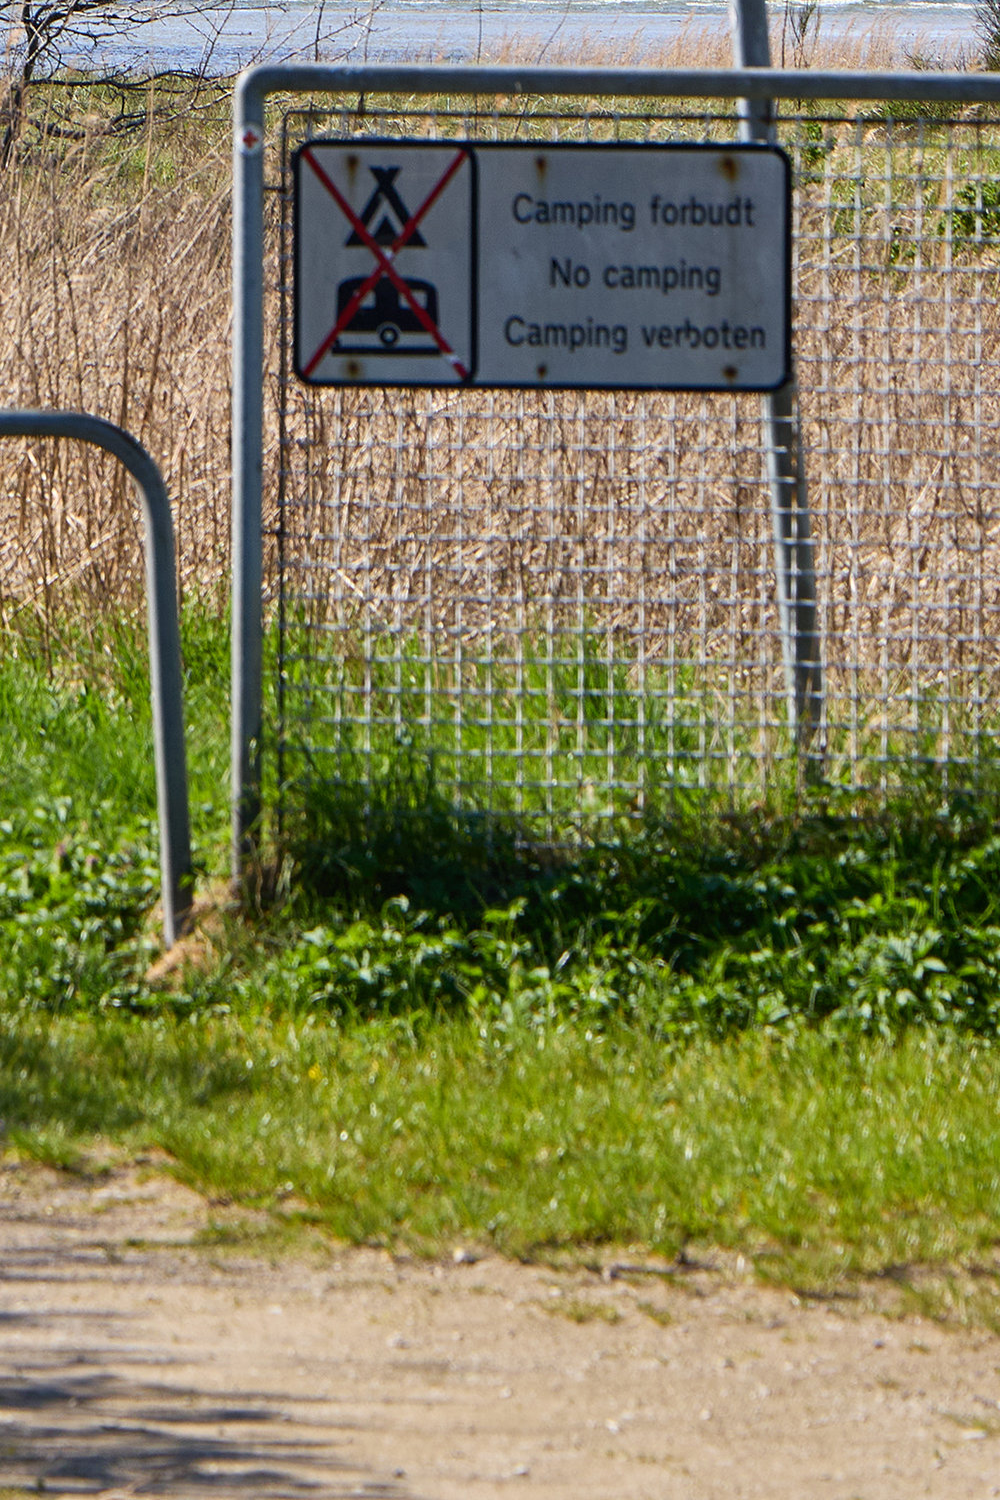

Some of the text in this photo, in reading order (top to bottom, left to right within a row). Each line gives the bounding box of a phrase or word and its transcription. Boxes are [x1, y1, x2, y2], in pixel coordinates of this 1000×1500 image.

[512, 193, 756, 231] Camping forbudt
[549, 258, 721, 296] No camping
[504, 315, 767, 353] Camping verboten
